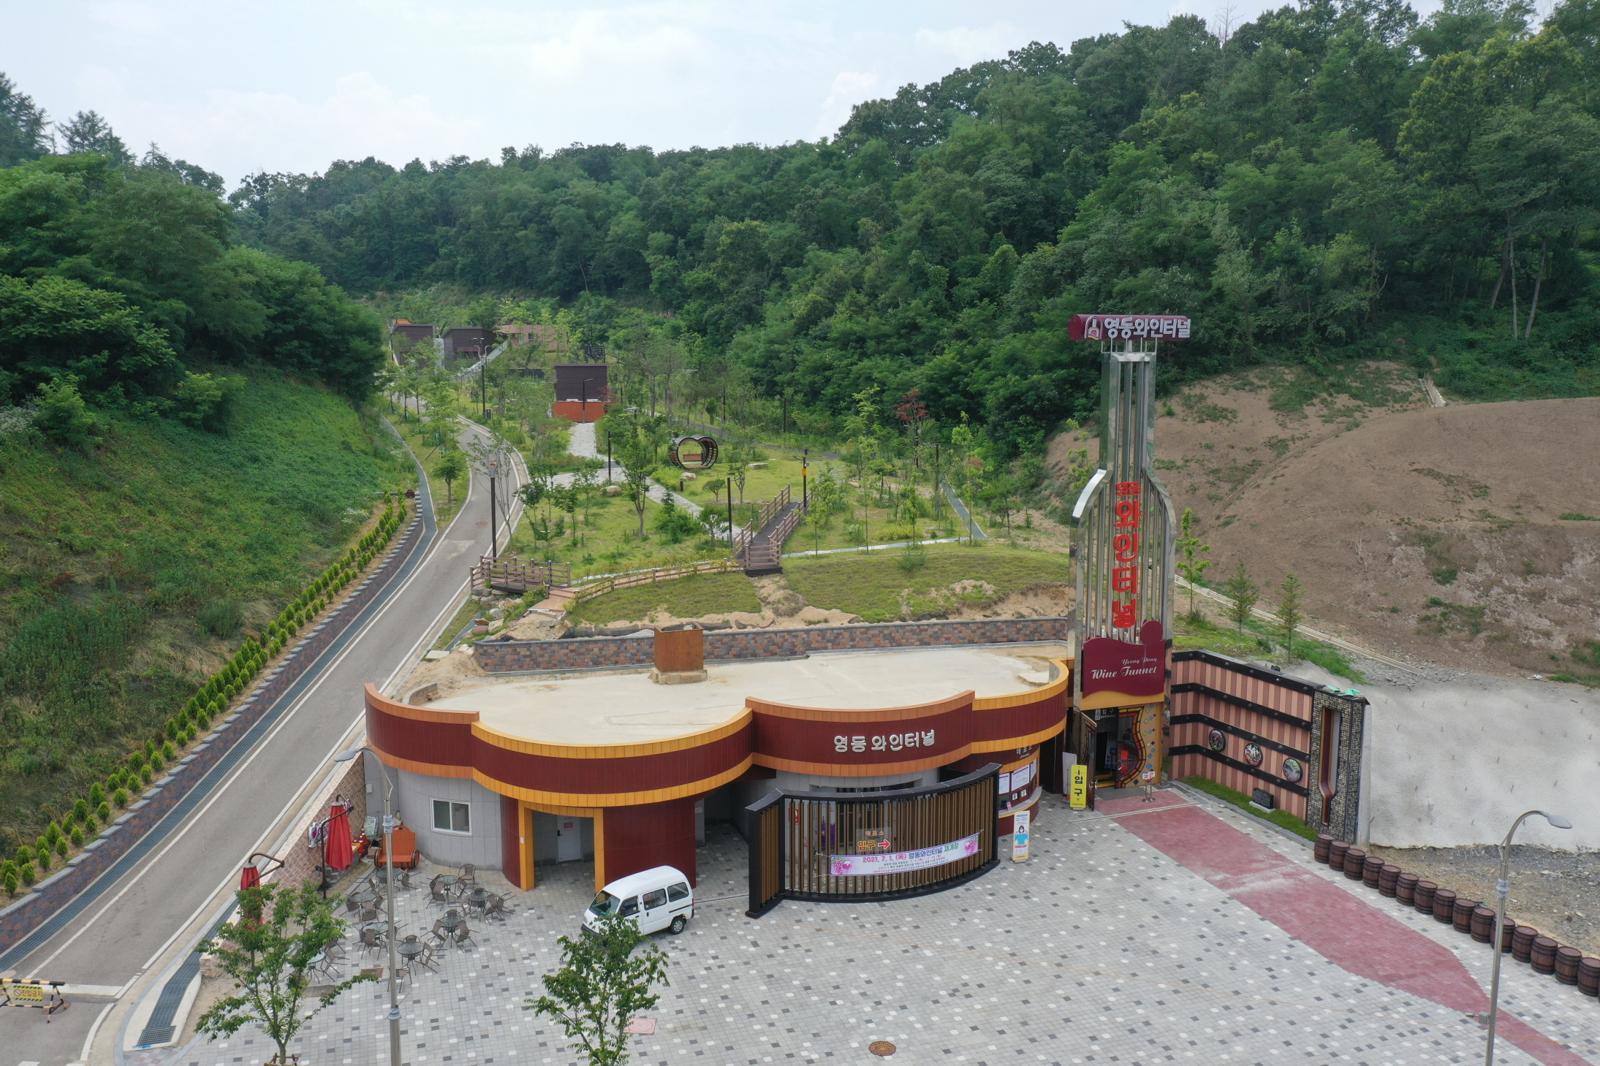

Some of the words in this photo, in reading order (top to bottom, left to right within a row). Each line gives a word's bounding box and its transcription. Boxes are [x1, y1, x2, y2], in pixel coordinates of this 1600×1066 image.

[1104, 317, 1191, 339] 영동와인터널
[1090, 669, 1117, 680] Wine
[1120, 666, 1157, 677] Tunnel
